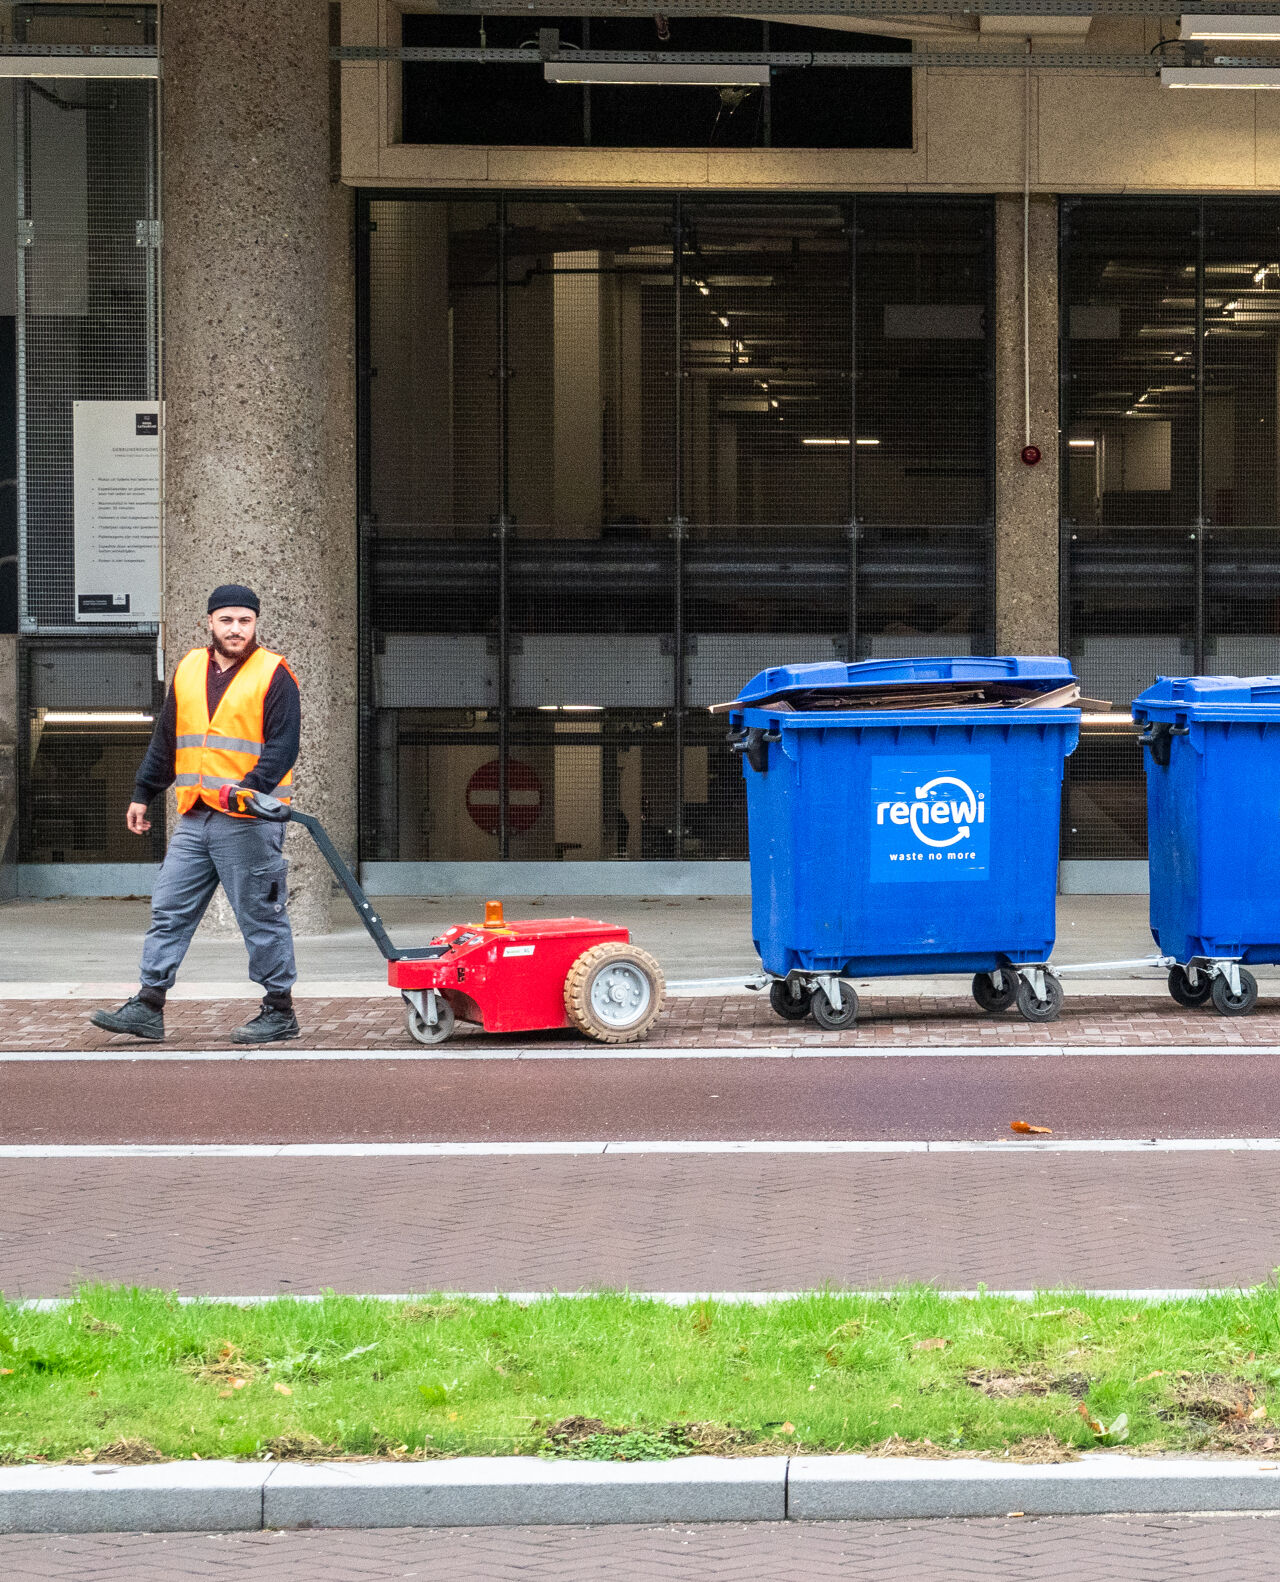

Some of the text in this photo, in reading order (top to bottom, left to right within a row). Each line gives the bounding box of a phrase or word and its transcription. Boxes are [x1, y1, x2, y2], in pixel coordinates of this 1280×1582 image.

[877, 785, 985, 833] renewi
[889, 851, 976, 861] waste no more
